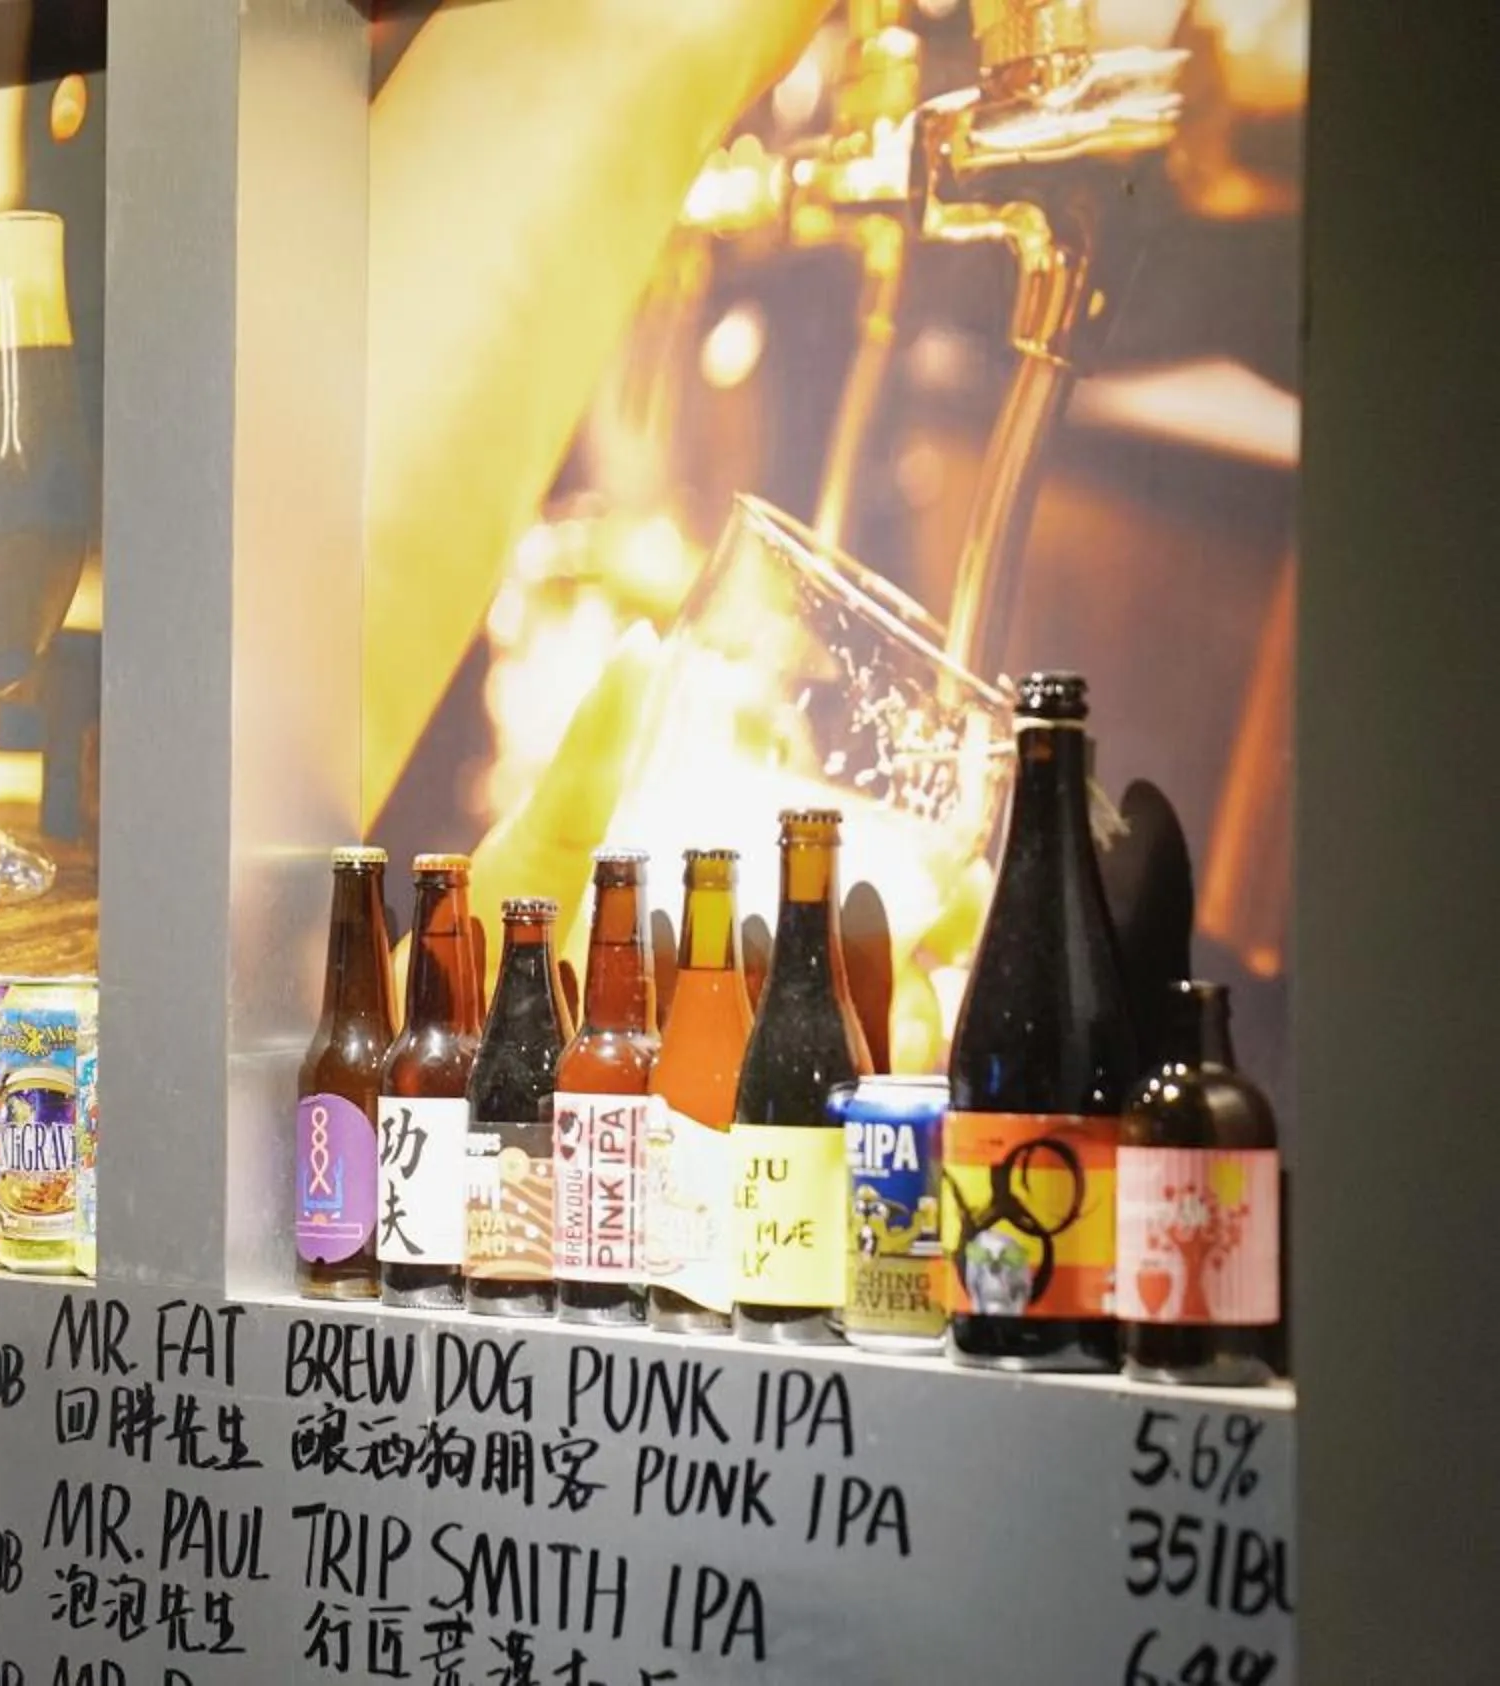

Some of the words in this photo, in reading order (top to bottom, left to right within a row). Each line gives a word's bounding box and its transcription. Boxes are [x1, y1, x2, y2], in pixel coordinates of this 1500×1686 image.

[380, 1107, 428, 1257] 功夫
[598, 1107, 627, 1164] IPA
[745, 1158, 789, 1182] JU
[564, 1168, 585, 1267] BREWDOG
[598, 1180, 626, 1270] PINK
[45, 1294, 138, 1377] MR.
[155, 1299, 248, 1387] FAT
[283, 1318, 417, 1405] BREW
[434, 1332, 535, 1421] DOG
[566, 1344, 732, 1445] PUNK
[752, 1368, 855, 1459] IPA
[633, 1445, 777, 1530] PUNK
[805, 1472, 913, 1557] IPA
[1130, 1407, 1267, 1507] 5.6%
[43, 1478, 146, 1565] MR.
[158, 1487, 271, 1581] PAUL
[48, 1563, 247, 1655] 泡泡先生
[291, 1500, 412, 1600] TRIP
[428, 1521, 628, 1641] SMITH
[661, 1562, 768, 1664] IPA
